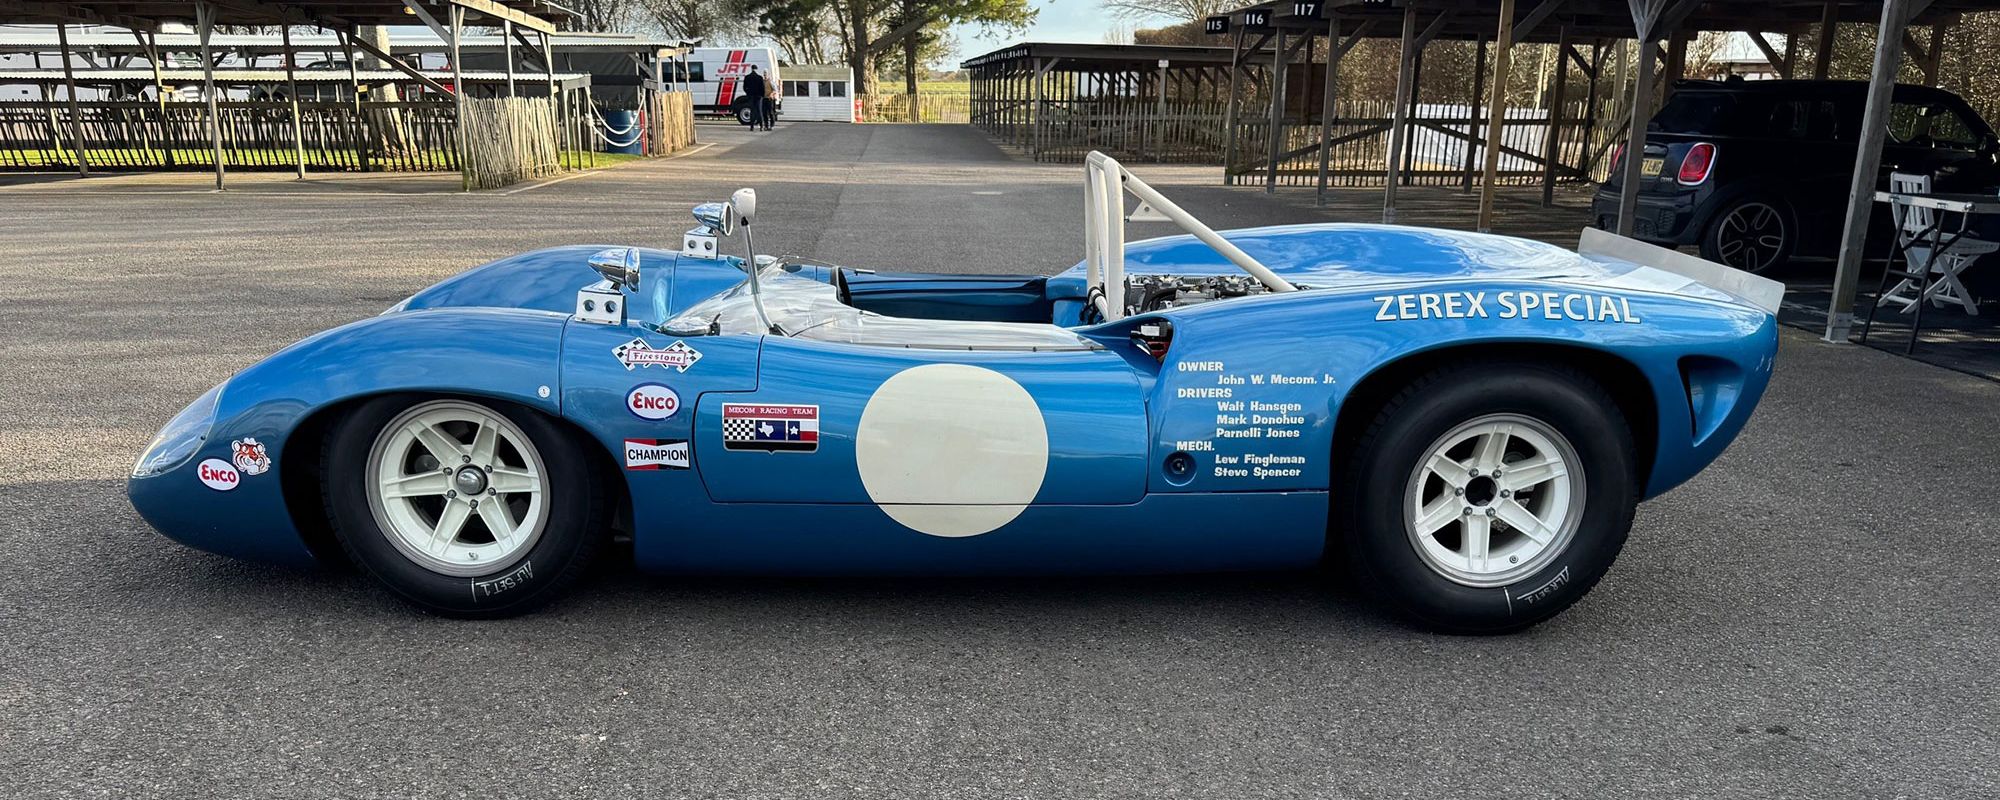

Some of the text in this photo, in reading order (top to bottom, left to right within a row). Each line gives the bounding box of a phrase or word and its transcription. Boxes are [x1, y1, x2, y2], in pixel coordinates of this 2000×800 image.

[1294, 3, 1315, 16] 117
[1245, 14, 1264, 25] 116
[1206, 20, 1222, 31] 115
[717, 64, 751, 74] JRT
[1373, 291, 1641, 324] ZEREX SPECIAL
[633, 352, 682, 362] Firestone
[1178, 361, 1224, 372] OWNER
[1217, 374, 1245, 385] John
[1250, 374, 1265, 385] W.
[1322, 373, 1336, 384] Jr.
[1177, 388, 1232, 398] DRIVERS
[633, 392, 675, 410] ENCO
[728, 406, 756, 414] MECOM
[760, 407, 788, 415] RACING
[1217, 401, 1302, 414] Walt Hansgen
[1216, 414, 1305, 425] Mark Donohue
[1216, 427, 1300, 438] Parnelli Jones
[1176, 441, 1215, 451] MECH.
[628, 449, 687, 461] CHAMPION
[1215, 454, 1306, 467] Lew Fingleman
[201, 464, 236, 483] ENCO
[1214, 467, 1301, 479] Steve Spencer
